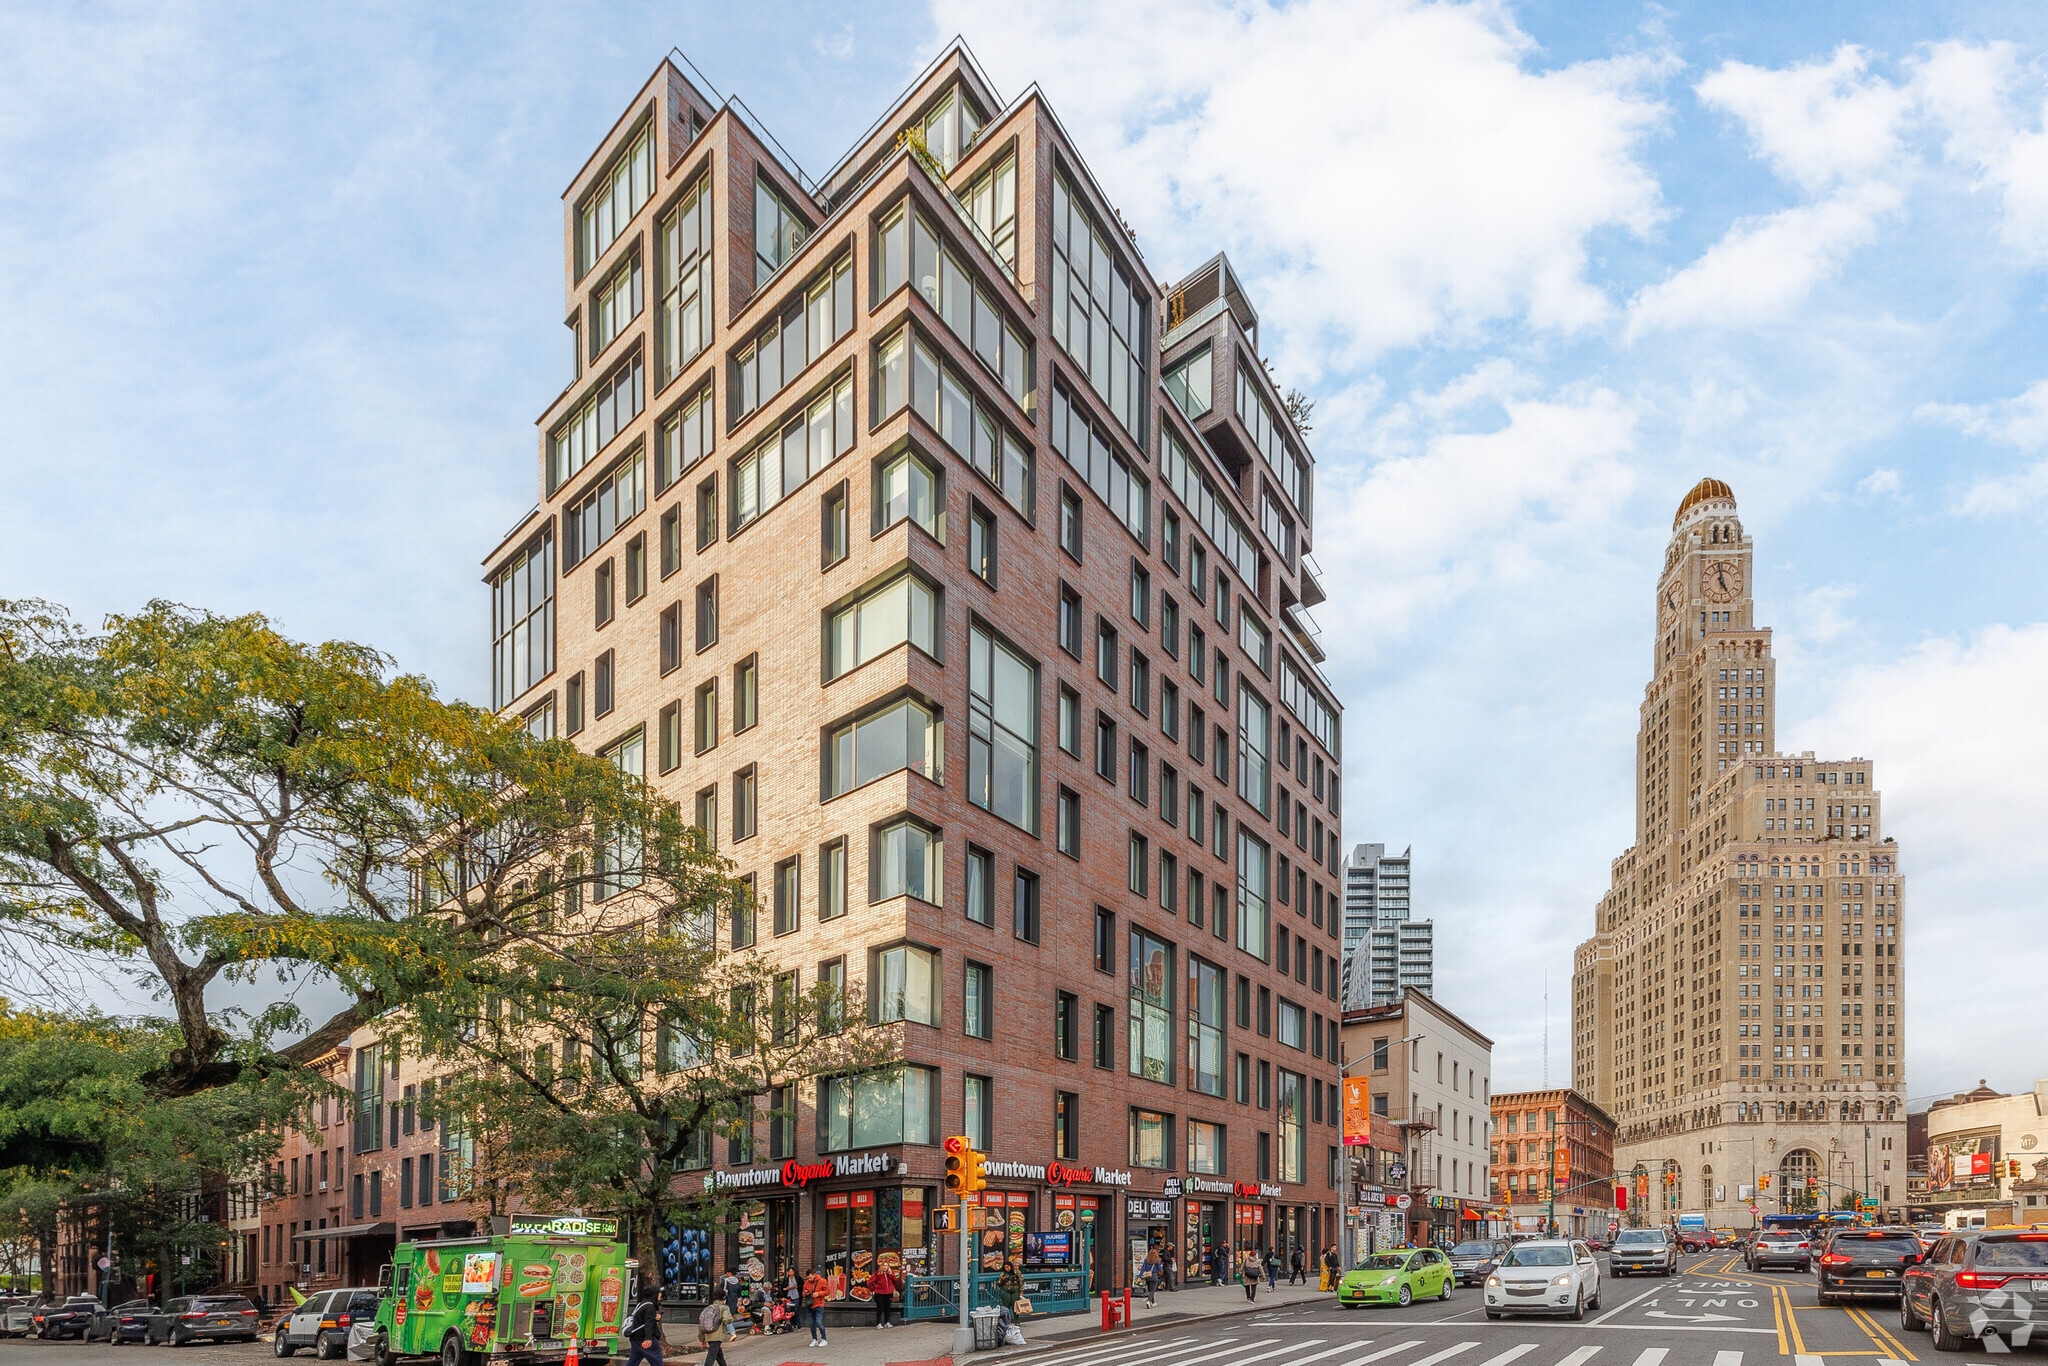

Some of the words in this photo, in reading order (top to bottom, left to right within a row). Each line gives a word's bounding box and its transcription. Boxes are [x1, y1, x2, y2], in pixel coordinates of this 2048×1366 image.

[716, 1168, 780, 1187] Downtown
[782, 1158, 834, 1188] Organic
[836, 1152, 889, 1176] Market
[980, 1160, 1045, 1179] owntown
[1047, 1161, 1093, 1187] Organic
[1095, 1167, 1132, 1185] Market
[1166, 1178, 1180, 1187] DELI
[1194, 1177, 1234, 1194] Downtown
[1260, 1183, 1282, 1197] Market
[1164, 1187, 1182, 1195] GRILL
[967, 1194, 978, 1202] GELS
[1128, 1200, 1147, 1213] DELI
[1151, 1201, 1170, 1214] GRILL
[1641, 1298, 1759, 1308] ONLY
